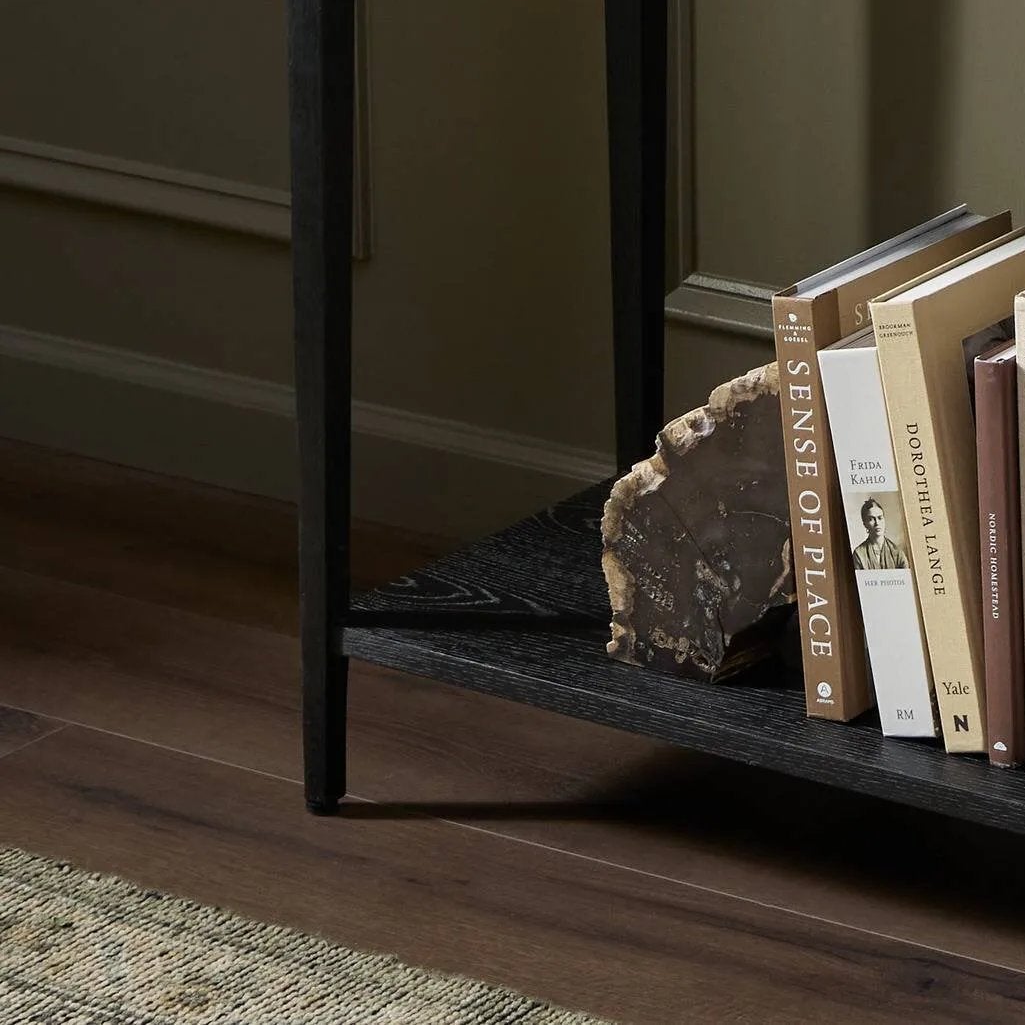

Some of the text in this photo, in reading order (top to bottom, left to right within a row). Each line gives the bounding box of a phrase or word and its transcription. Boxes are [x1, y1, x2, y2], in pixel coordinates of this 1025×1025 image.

[786, 359, 833, 657] SENSE OF PLACE
[906, 423, 946, 596] DOROTHEA LANGE
[989, 513, 999, 619] NORDIC HOMESTEAD
[896, 709, 914, 720] RM
[942, 682, 970, 695] Yale
